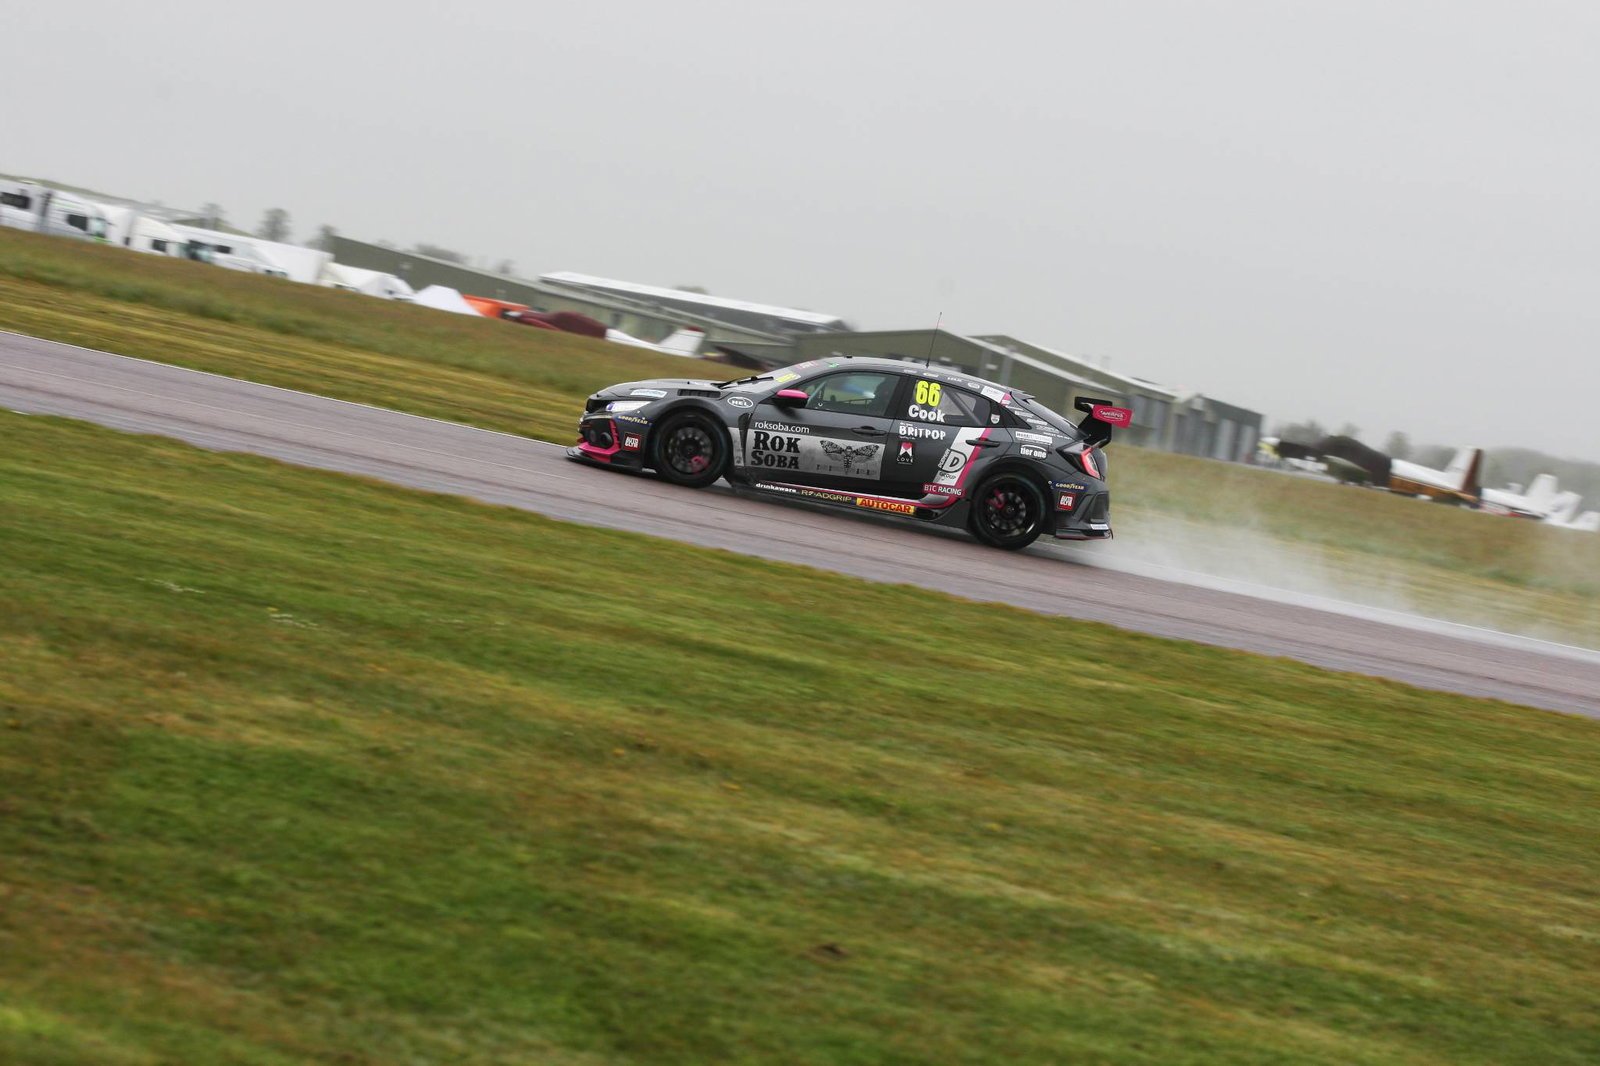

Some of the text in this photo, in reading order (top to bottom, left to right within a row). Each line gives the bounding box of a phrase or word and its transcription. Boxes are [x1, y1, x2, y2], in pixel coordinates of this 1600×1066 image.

[916, 380, 941, 407] 66
[618, 415, 648, 424] GOODYEAR
[908, 404, 945, 423] Cook
[754, 421, 810, 434] roksoba.com
[752, 431, 801, 453] ROK
[750, 450, 800, 470] SOBA
[1020, 447, 1047, 459] tier one
[924, 484, 962, 496] BTC RACING
[1055, 482, 1085, 490] GOODYEAR
[859, 498, 912, 514] AUTOCAR
